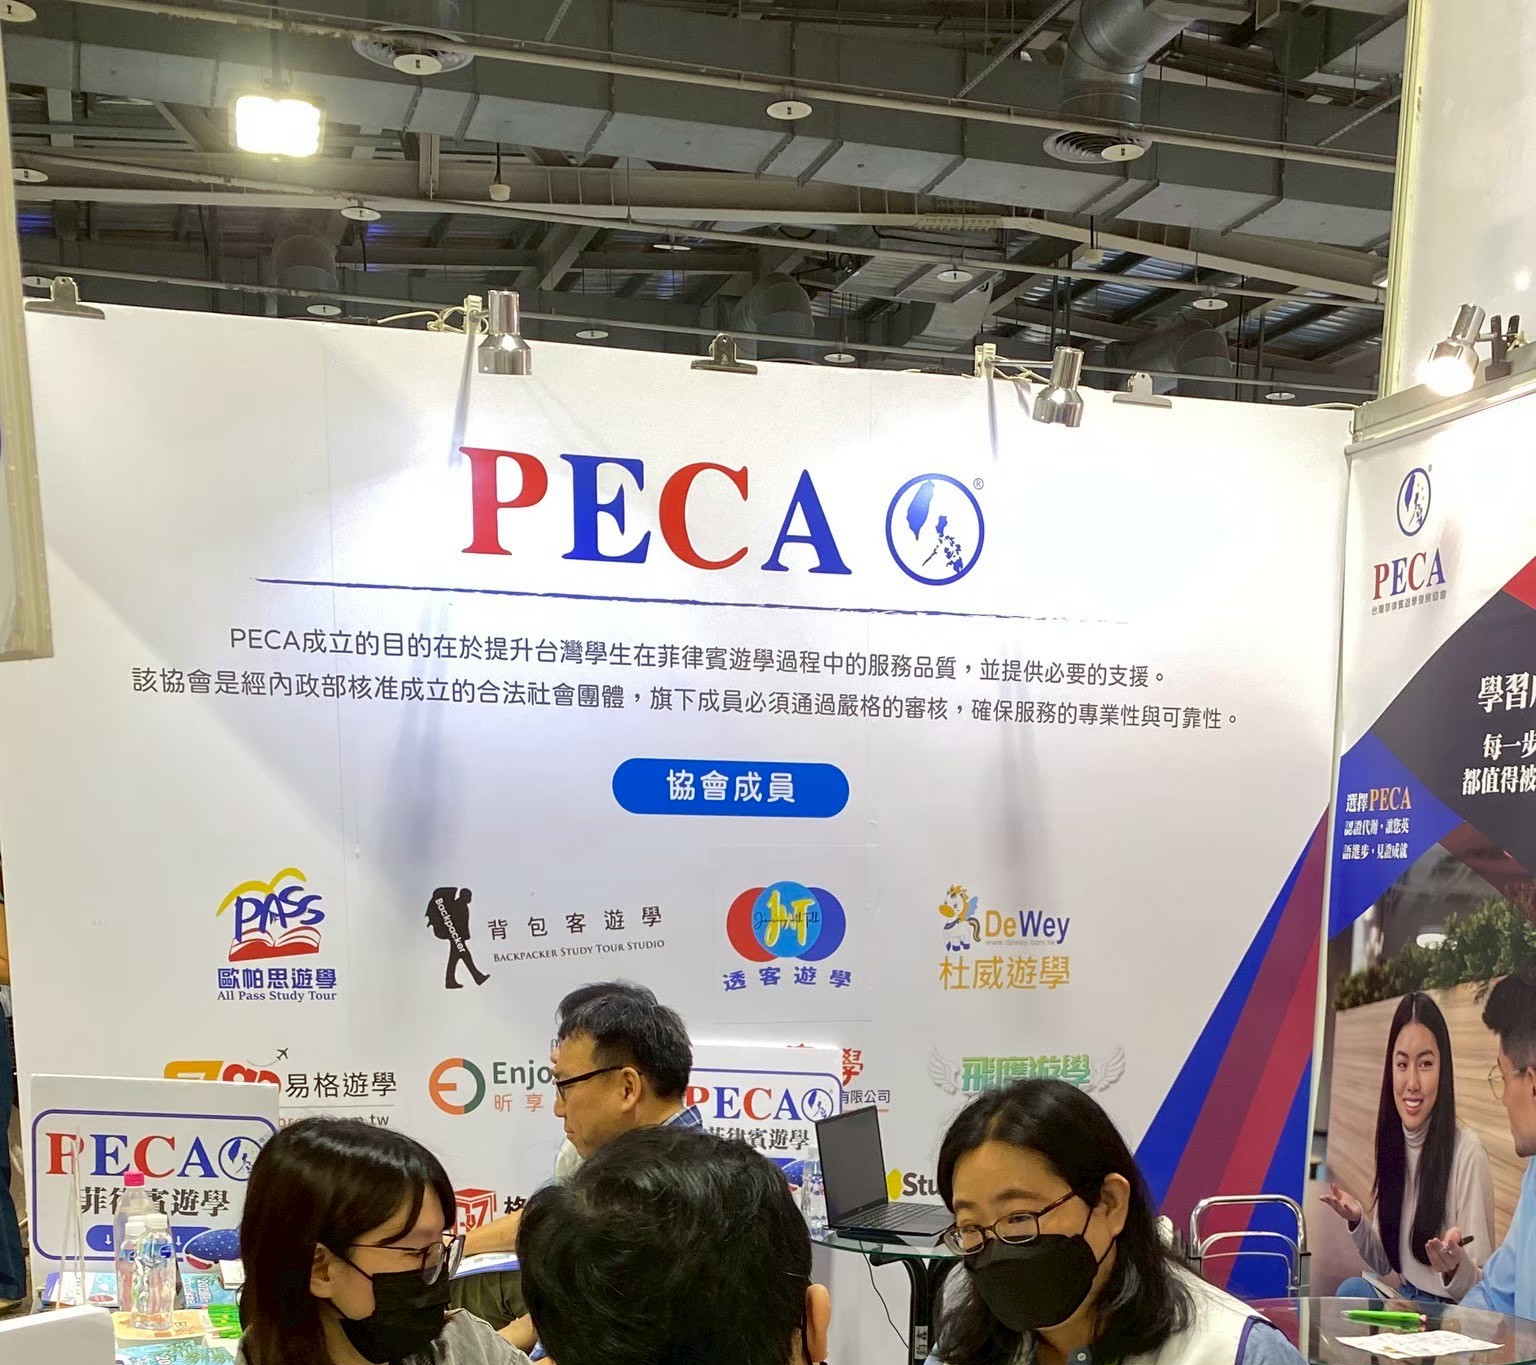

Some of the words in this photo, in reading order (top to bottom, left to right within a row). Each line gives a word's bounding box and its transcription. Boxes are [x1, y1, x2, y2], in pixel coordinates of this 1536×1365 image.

[459, 446, 853, 576] PECA
[1373, 547, 1446, 600] PECA
[1478, 671, 1536, 714] 學習
[666, 768, 796, 804] 協會成員
[434, 897, 466, 954] Backpacker
[217, 967, 337, 990] 歐帕思遊學
[723, 966, 852, 992] 透客遊學
[938, 955, 1070, 991] 杜威遊學
[217, 990, 235, 1001] All
[239, 990, 266, 1001] Pass
[269, 990, 305, 1003] Study
[308, 990, 337, 1001] Tour
[285, 1071, 397, 1099] 易格遊學
[684, 1084, 803, 1122] PECA
[45, 1131, 219, 1179] PECA
